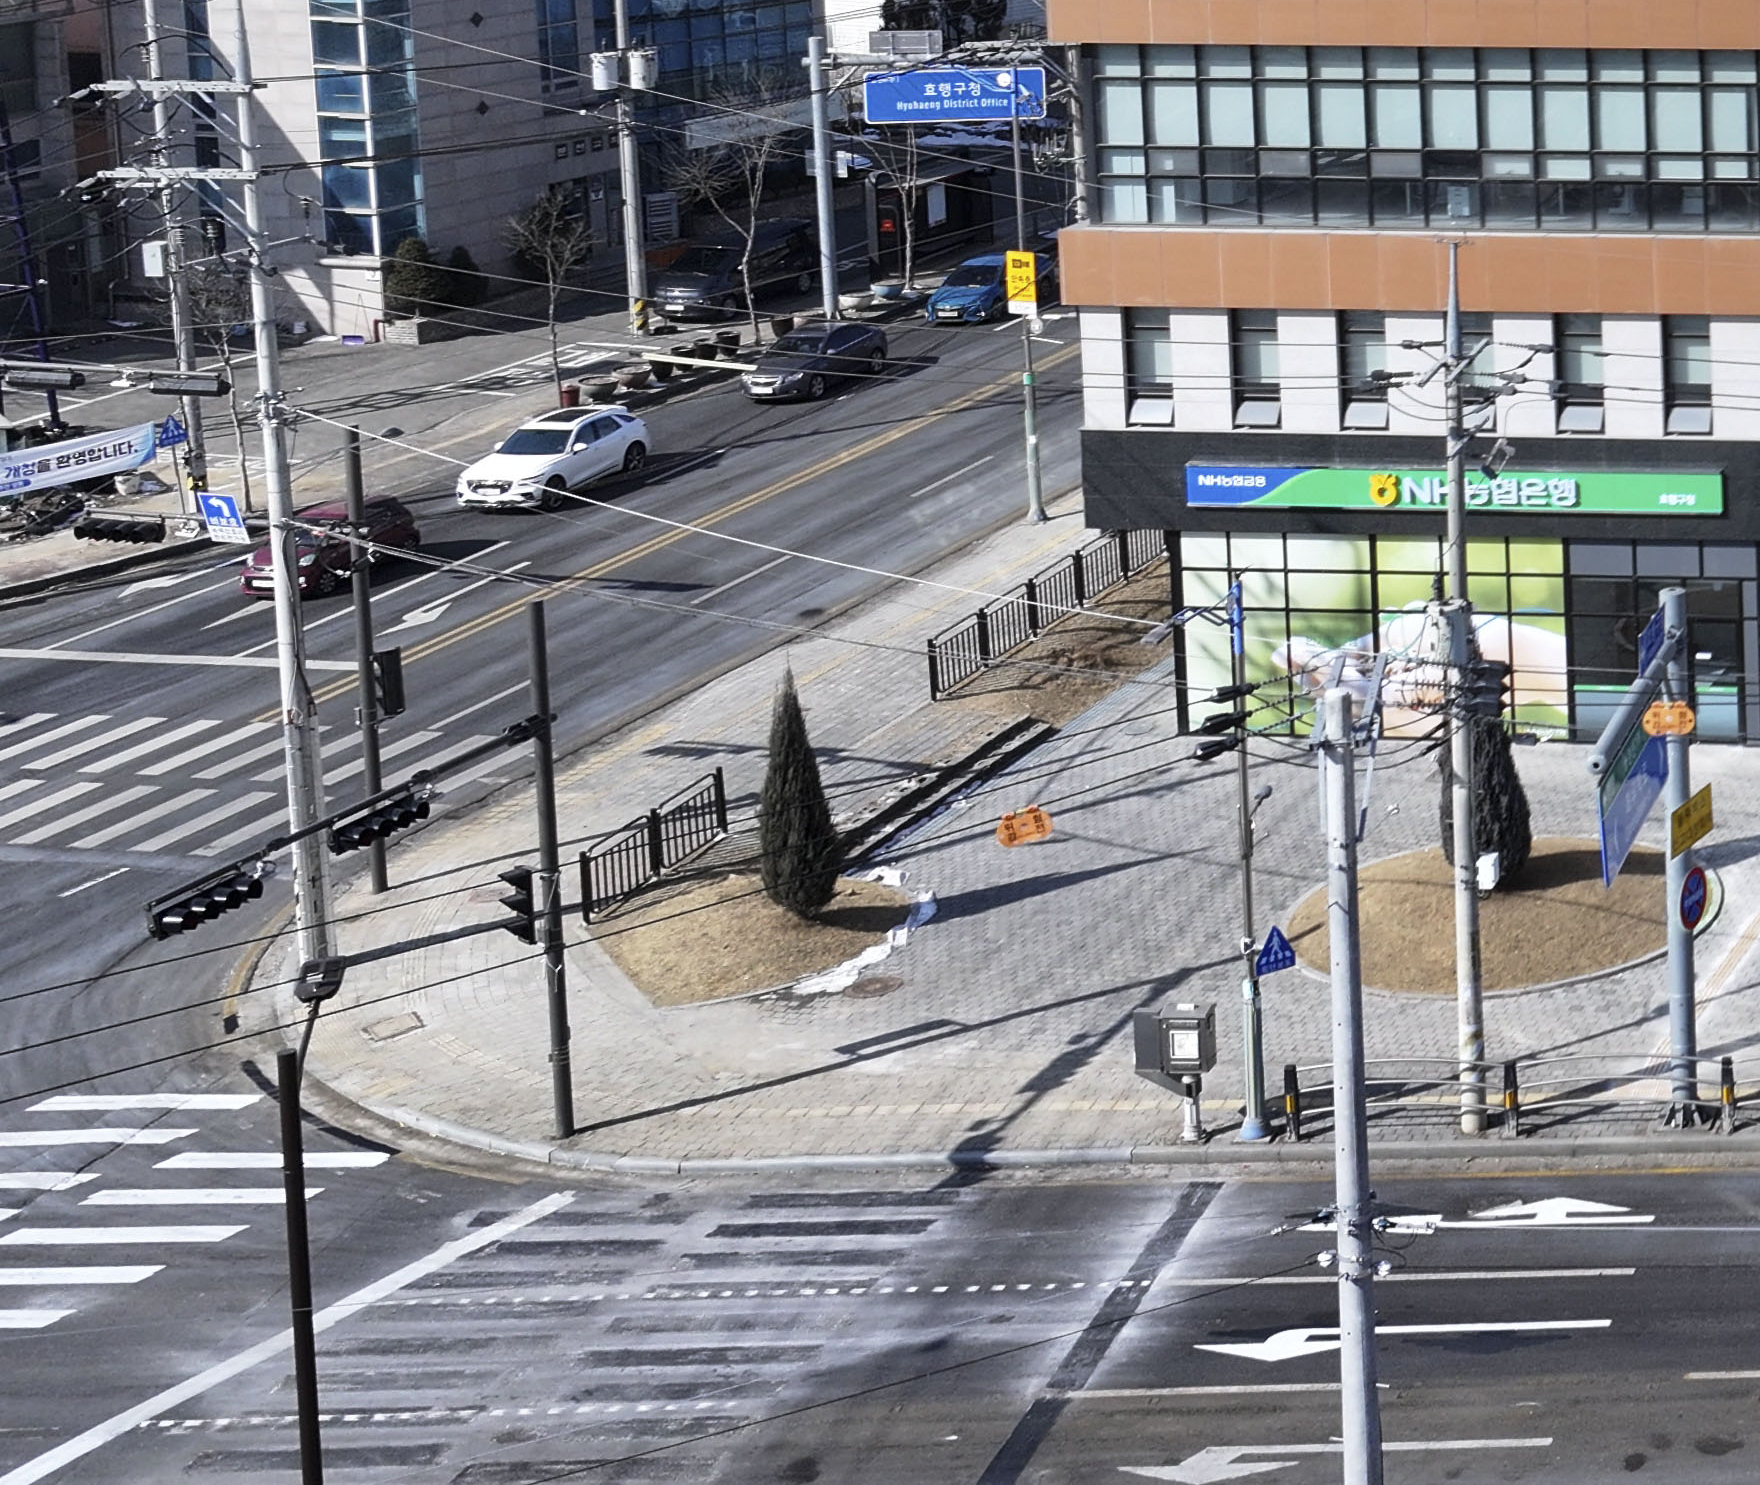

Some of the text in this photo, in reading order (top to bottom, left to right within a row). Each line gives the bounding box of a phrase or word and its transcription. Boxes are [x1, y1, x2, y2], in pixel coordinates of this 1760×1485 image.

[923, 82, 982, 97] 효행구청
[896, 98, 1009, 112] Hyohaeng District Office
[4, 440, 139, 479] 개청을 환영합니다.
